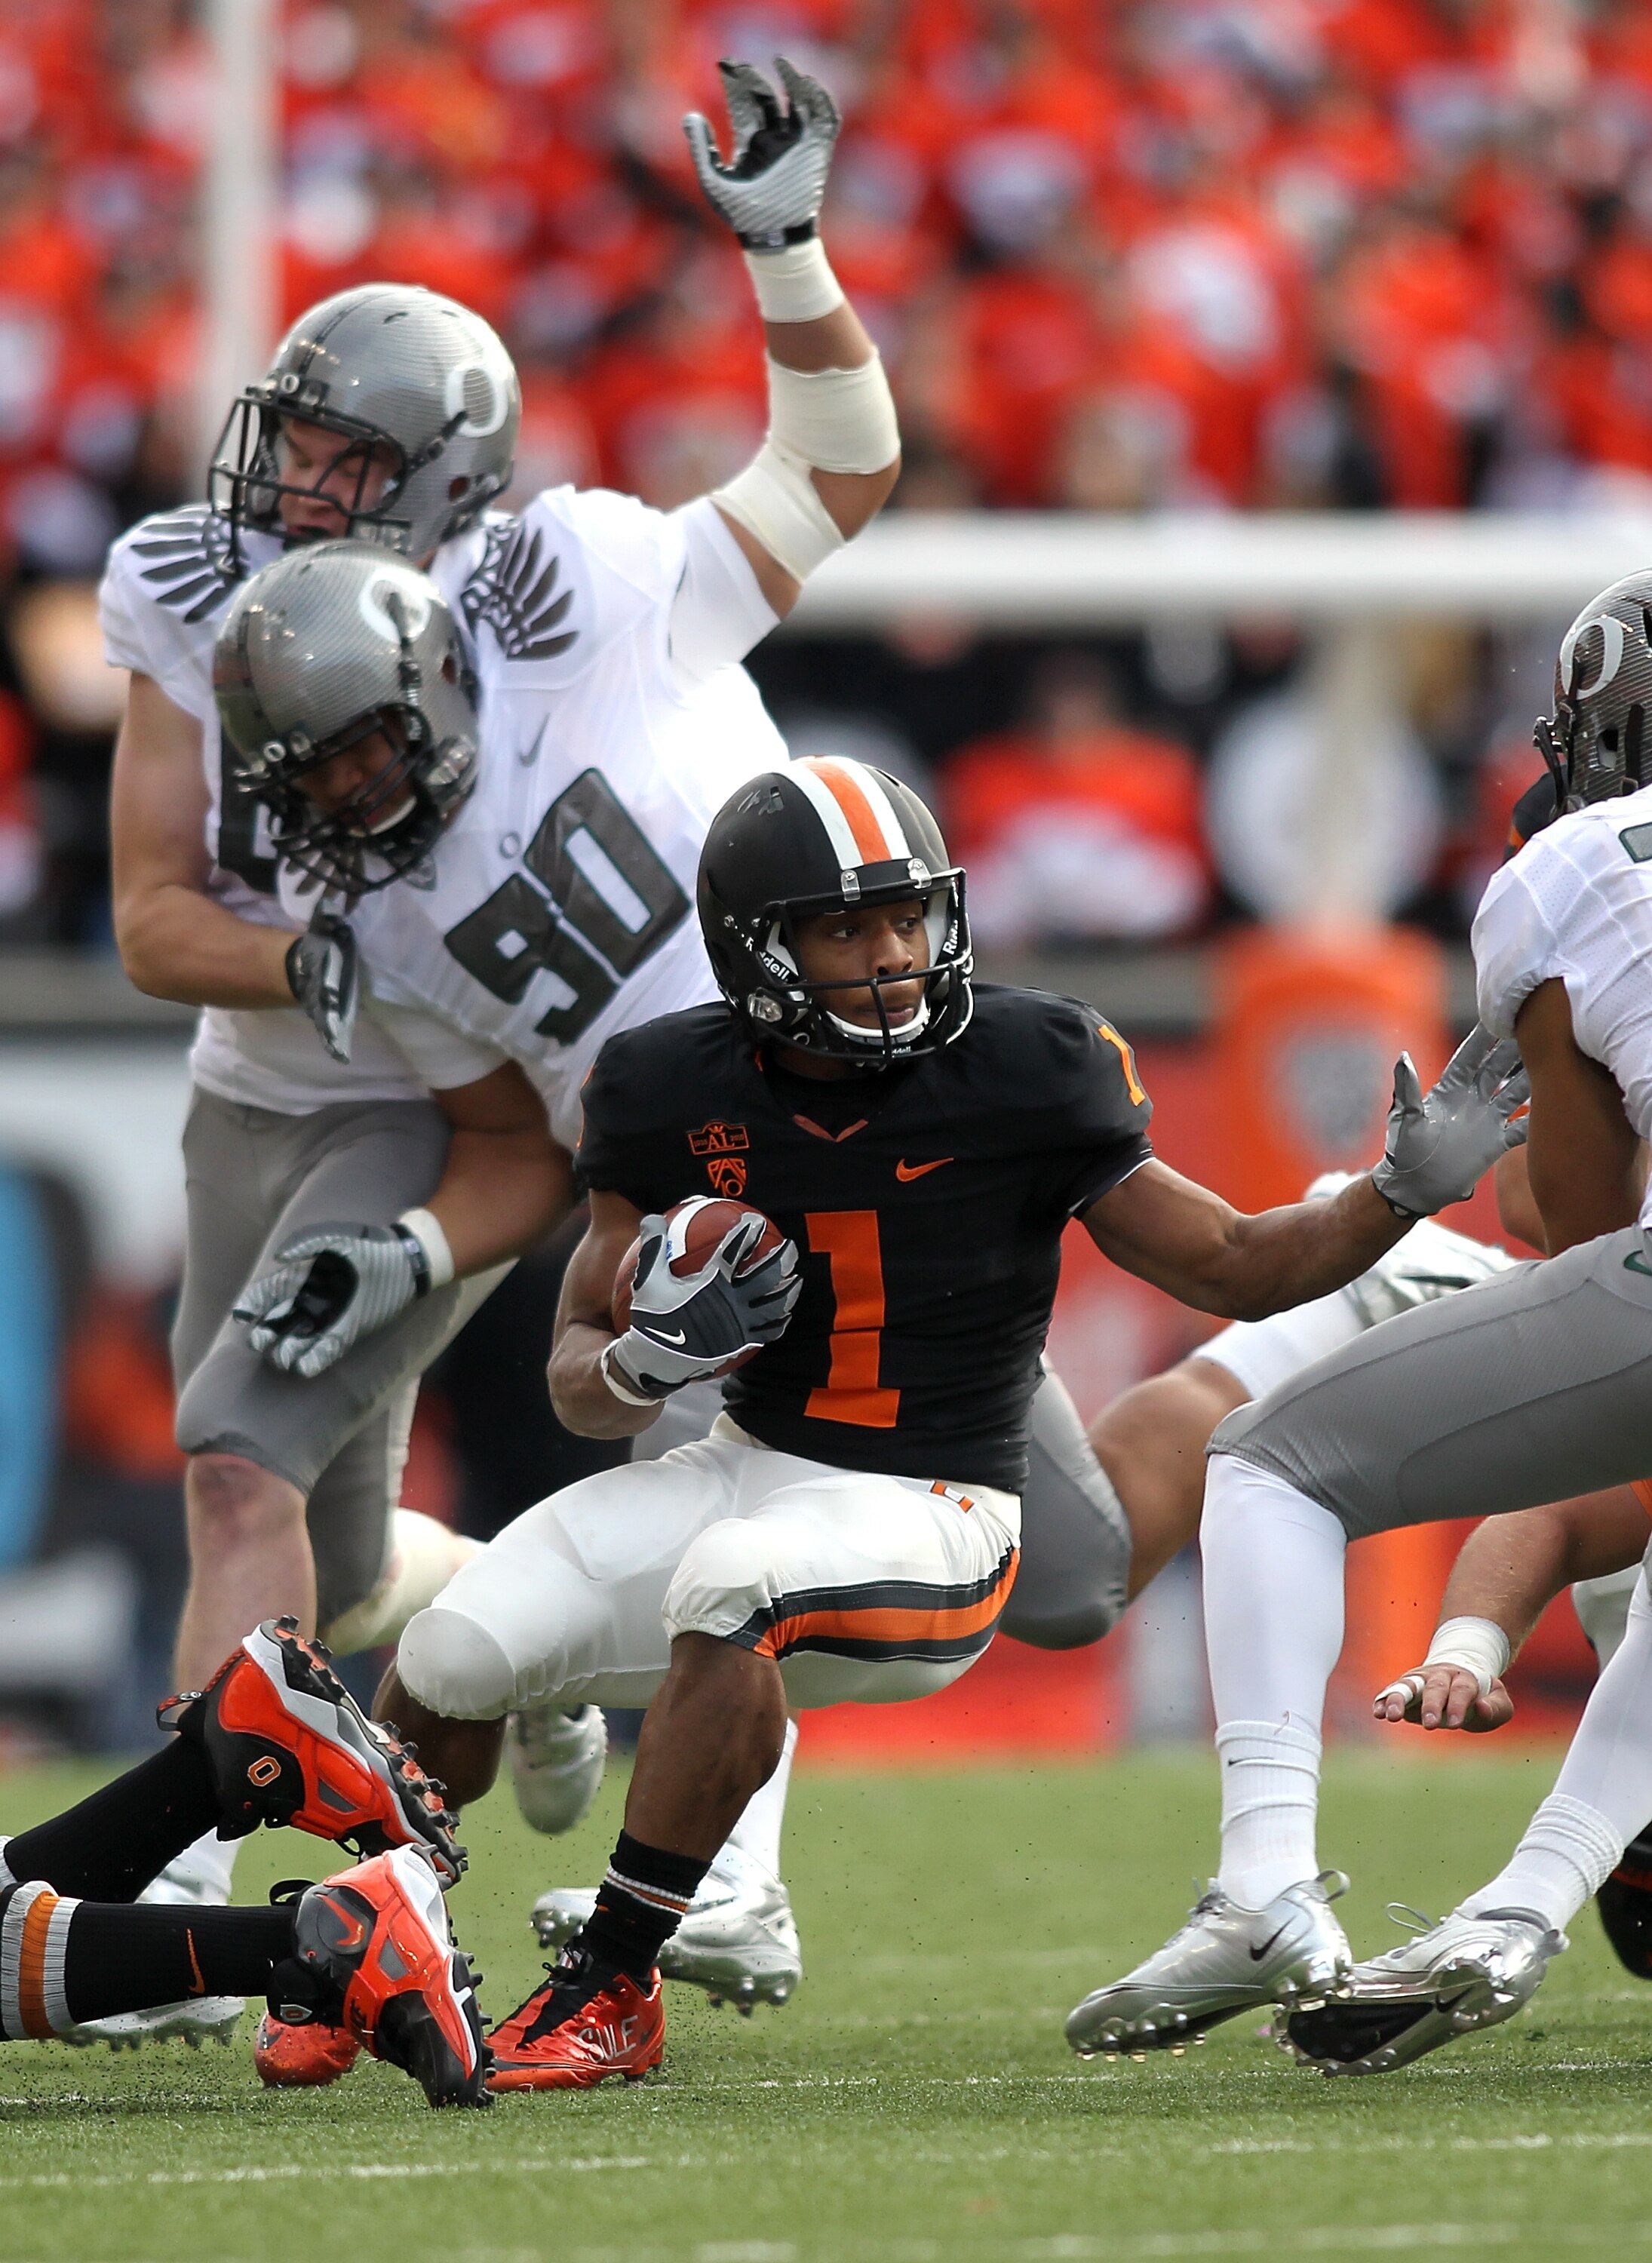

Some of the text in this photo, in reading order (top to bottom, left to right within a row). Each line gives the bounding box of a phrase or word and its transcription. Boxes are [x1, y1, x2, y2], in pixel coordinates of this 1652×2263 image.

[1559, 616, 1624, 702] O
[1098, 1024, 1146, 1107] 1
[803, 1210, 901, 1428] 1
